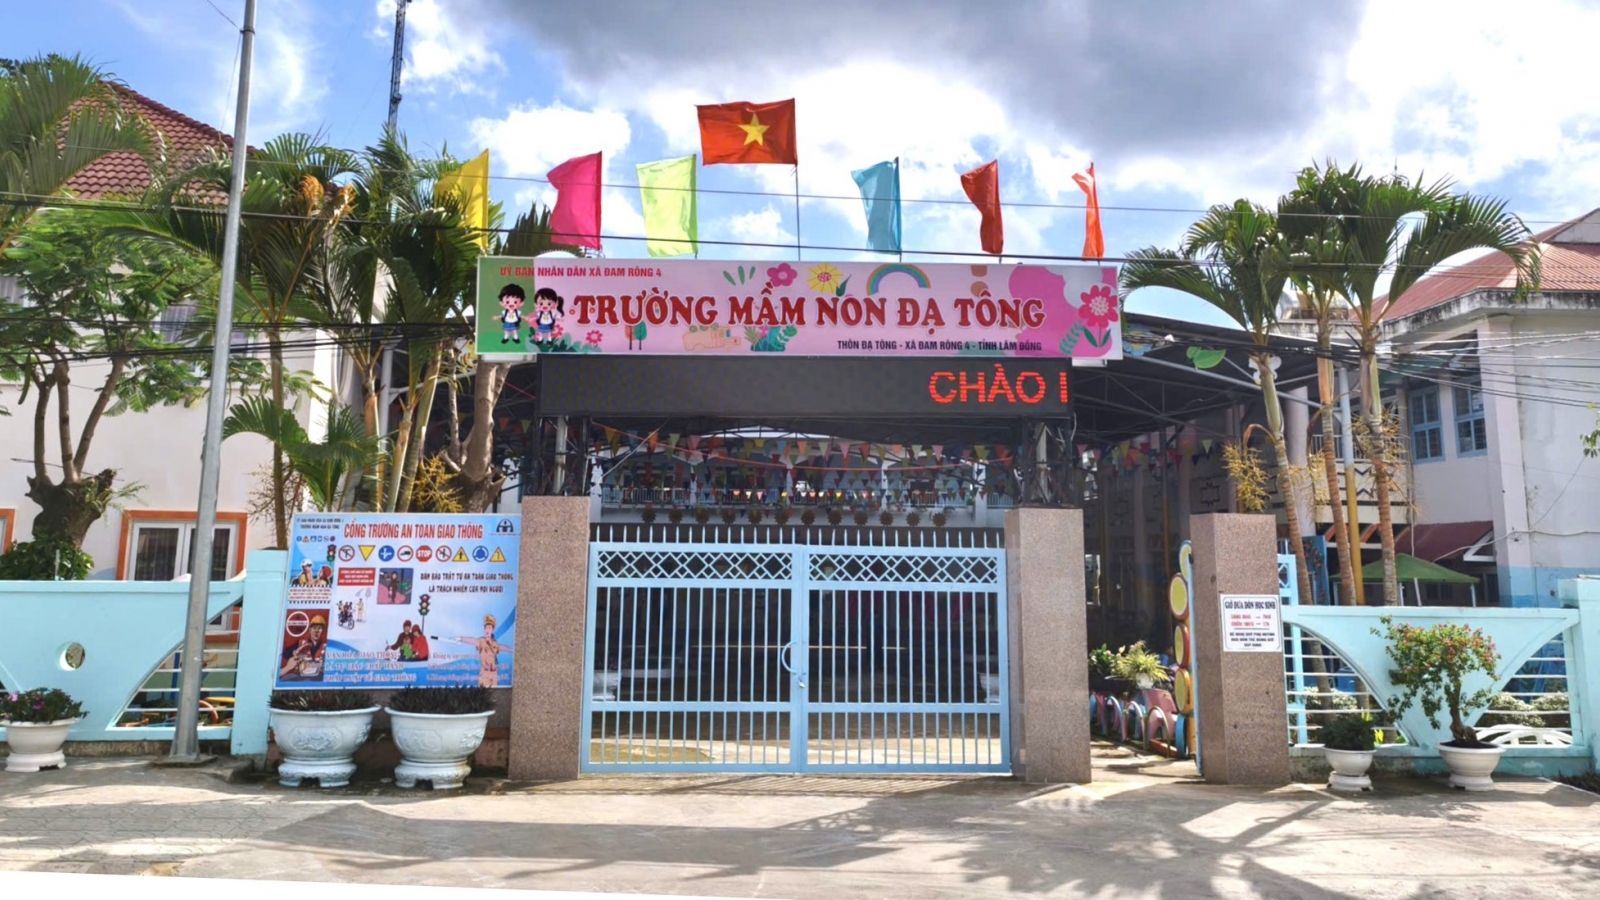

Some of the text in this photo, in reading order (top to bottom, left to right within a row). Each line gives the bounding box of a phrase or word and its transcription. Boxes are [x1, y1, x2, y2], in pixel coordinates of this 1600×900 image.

[515, 266, 535, 276] BAN
[537, 265, 564, 277] NHÂN
[567, 265, 586, 277] DÂN
[589, 265, 601, 277] XÃ
[604, 267, 625, 277] ĐAM
[628, 266, 653, 277] RÔNG
[656, 268, 662, 277] 4
[573, 281, 1045, 335] TRƯỜNG MẦM NON ĐẠ TÔNG
[837, 338, 859, 350] THÔN
[861, 340, 873, 351] ĐẠ
[875, 339, 897, 350] TÔNG
[905, 339, 916, 350] XÃ
[918, 340, 938, 350] ĐAM
[940, 339, 962, 350] RÔNG
[965, 341, 970, 350] 4
[978, 338, 997, 350] TỈNH
[999, 339, 1017, 351] LÂM
[928, 362, 1047, 403] CHÀO
[344, 518, 366, 538] CỔNG
[368, 521, 399, 538] TRƯỜNG
[401, 523, 412, 538] AN
[437, 524, 455, 539] GIAO
[457, 521, 483, 539] THÔNG
[417, 549, 431, 558] STOP
